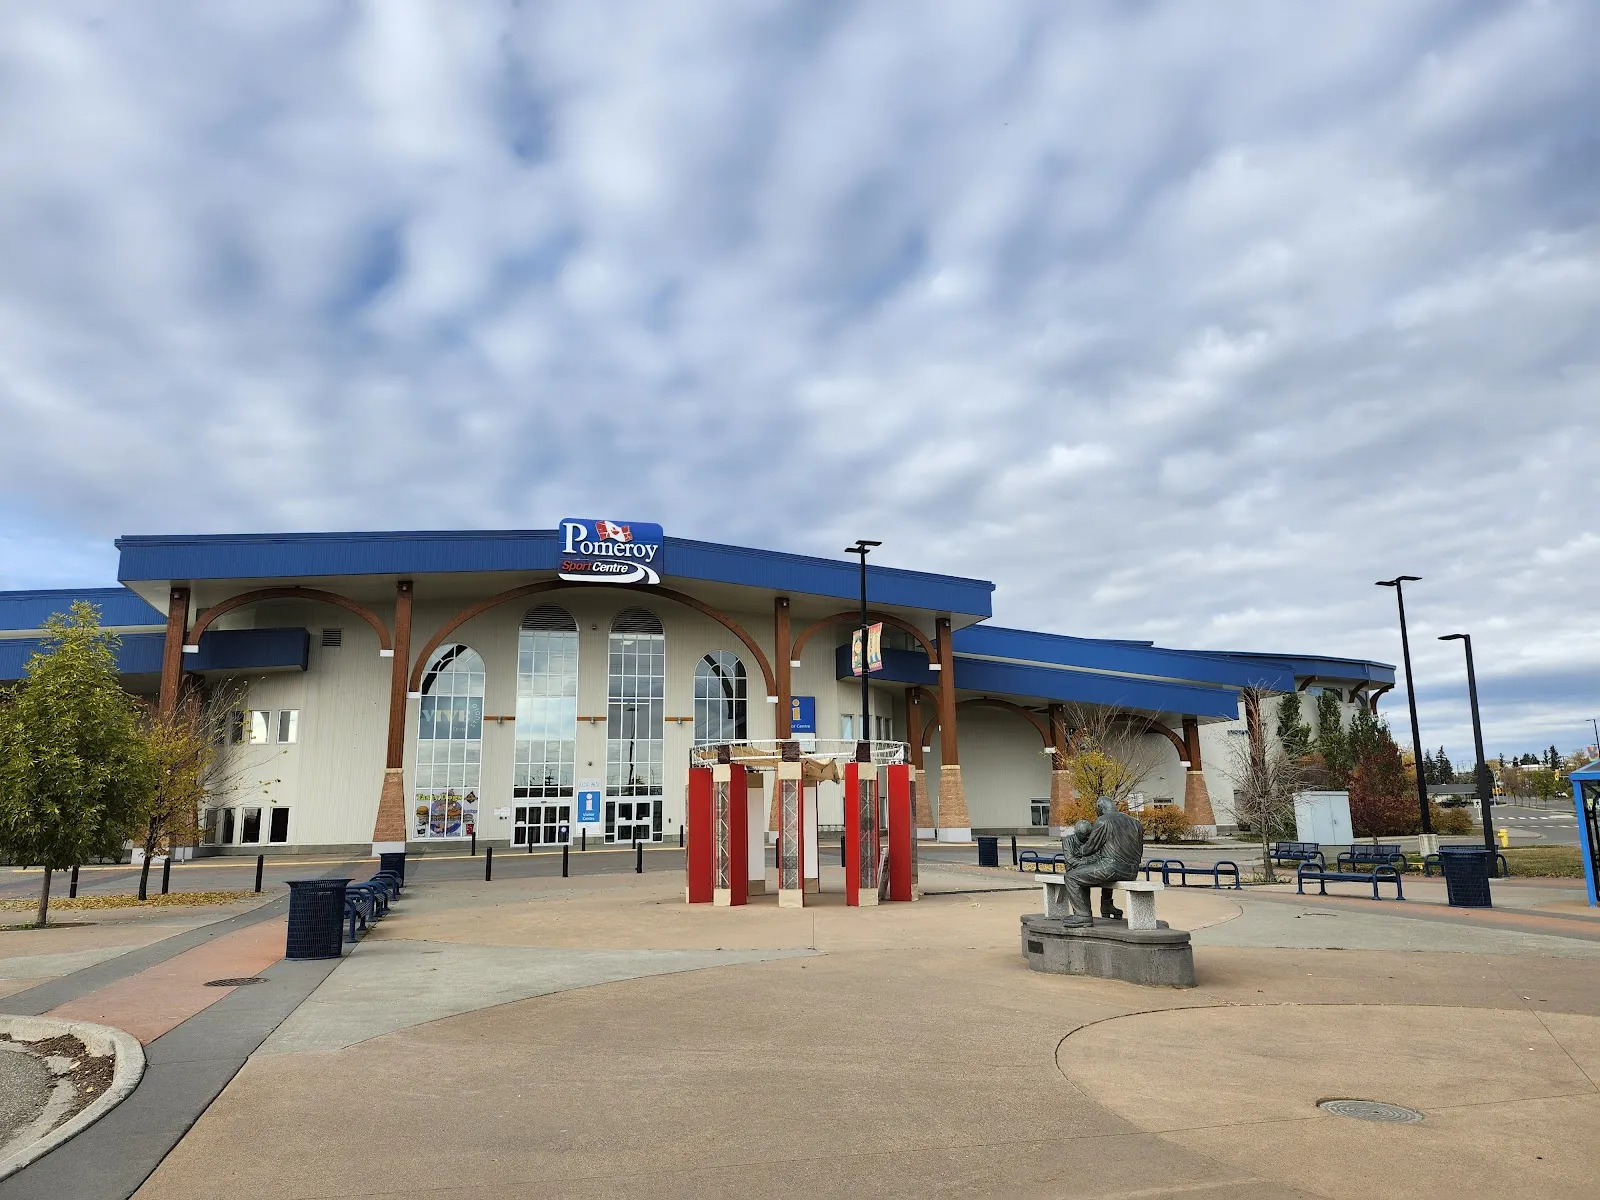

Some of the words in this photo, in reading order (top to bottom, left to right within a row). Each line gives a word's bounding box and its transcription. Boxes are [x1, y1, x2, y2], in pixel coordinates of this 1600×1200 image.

[562, 522, 658, 563] Pomeroy
[561, 560, 592, 571] Sport
[592, 561, 629, 573] Centre
